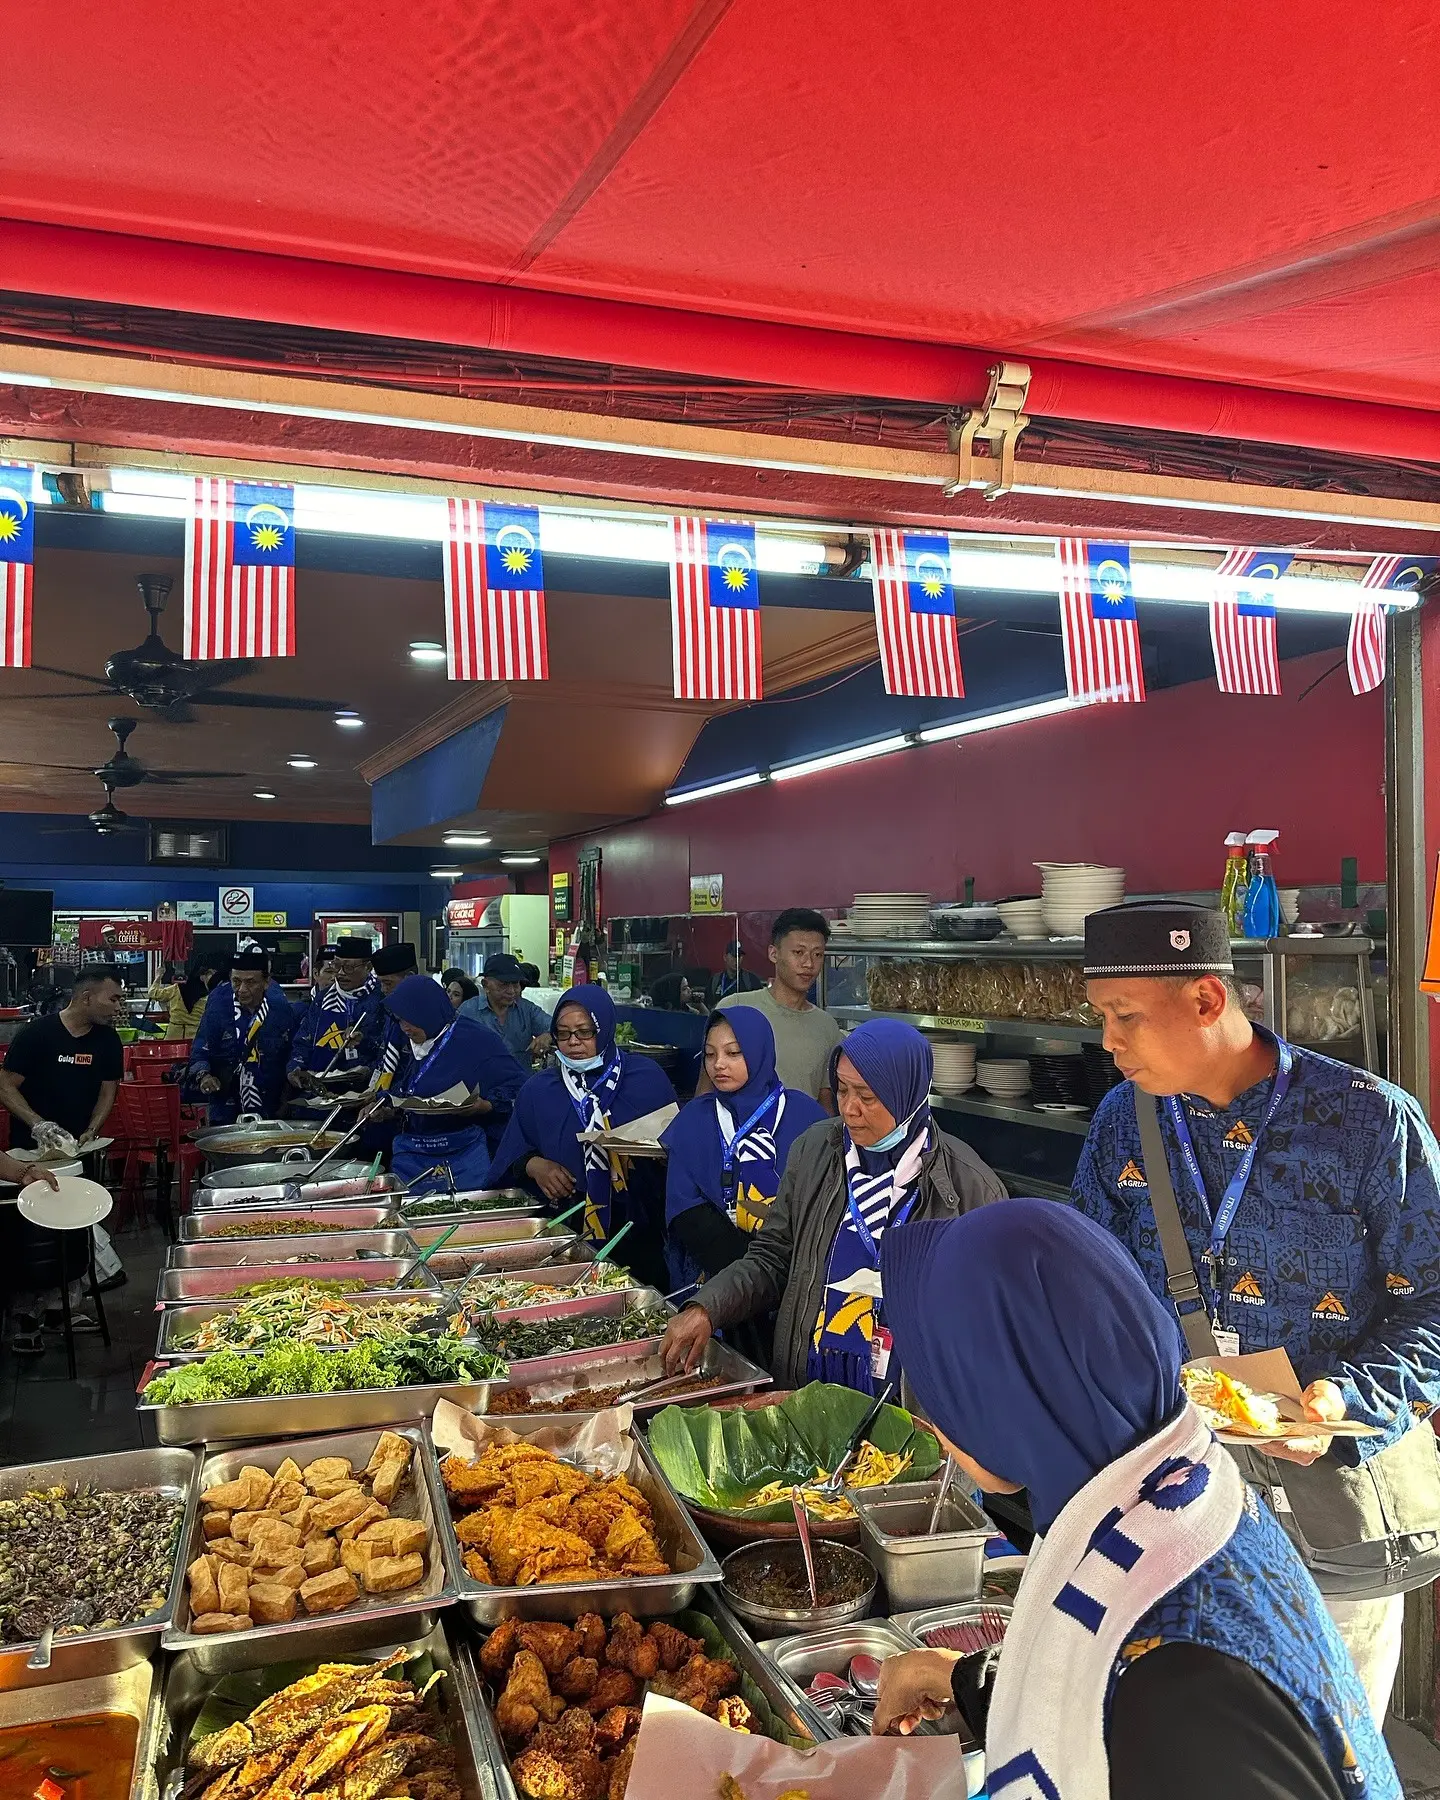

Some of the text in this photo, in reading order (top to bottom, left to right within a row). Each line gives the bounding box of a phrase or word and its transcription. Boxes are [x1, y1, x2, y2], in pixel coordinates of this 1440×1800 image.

[118, 935, 139, 943] COFFEE
[1351, 1080, 1366, 1089] ITS
[1222, 1140, 1235, 1149] ITS
[1127, 1179, 1148, 1188] GRUP
[1218, 1196, 1236, 1231] ITS GRUP
[1392, 1287, 1415, 1296] GRUP
[1229, 1293, 1267, 1307] ITS GRUP
[1312, 1311, 1350, 1322] ITS GRUP
[1341, 1766, 1365, 1784] ITS
